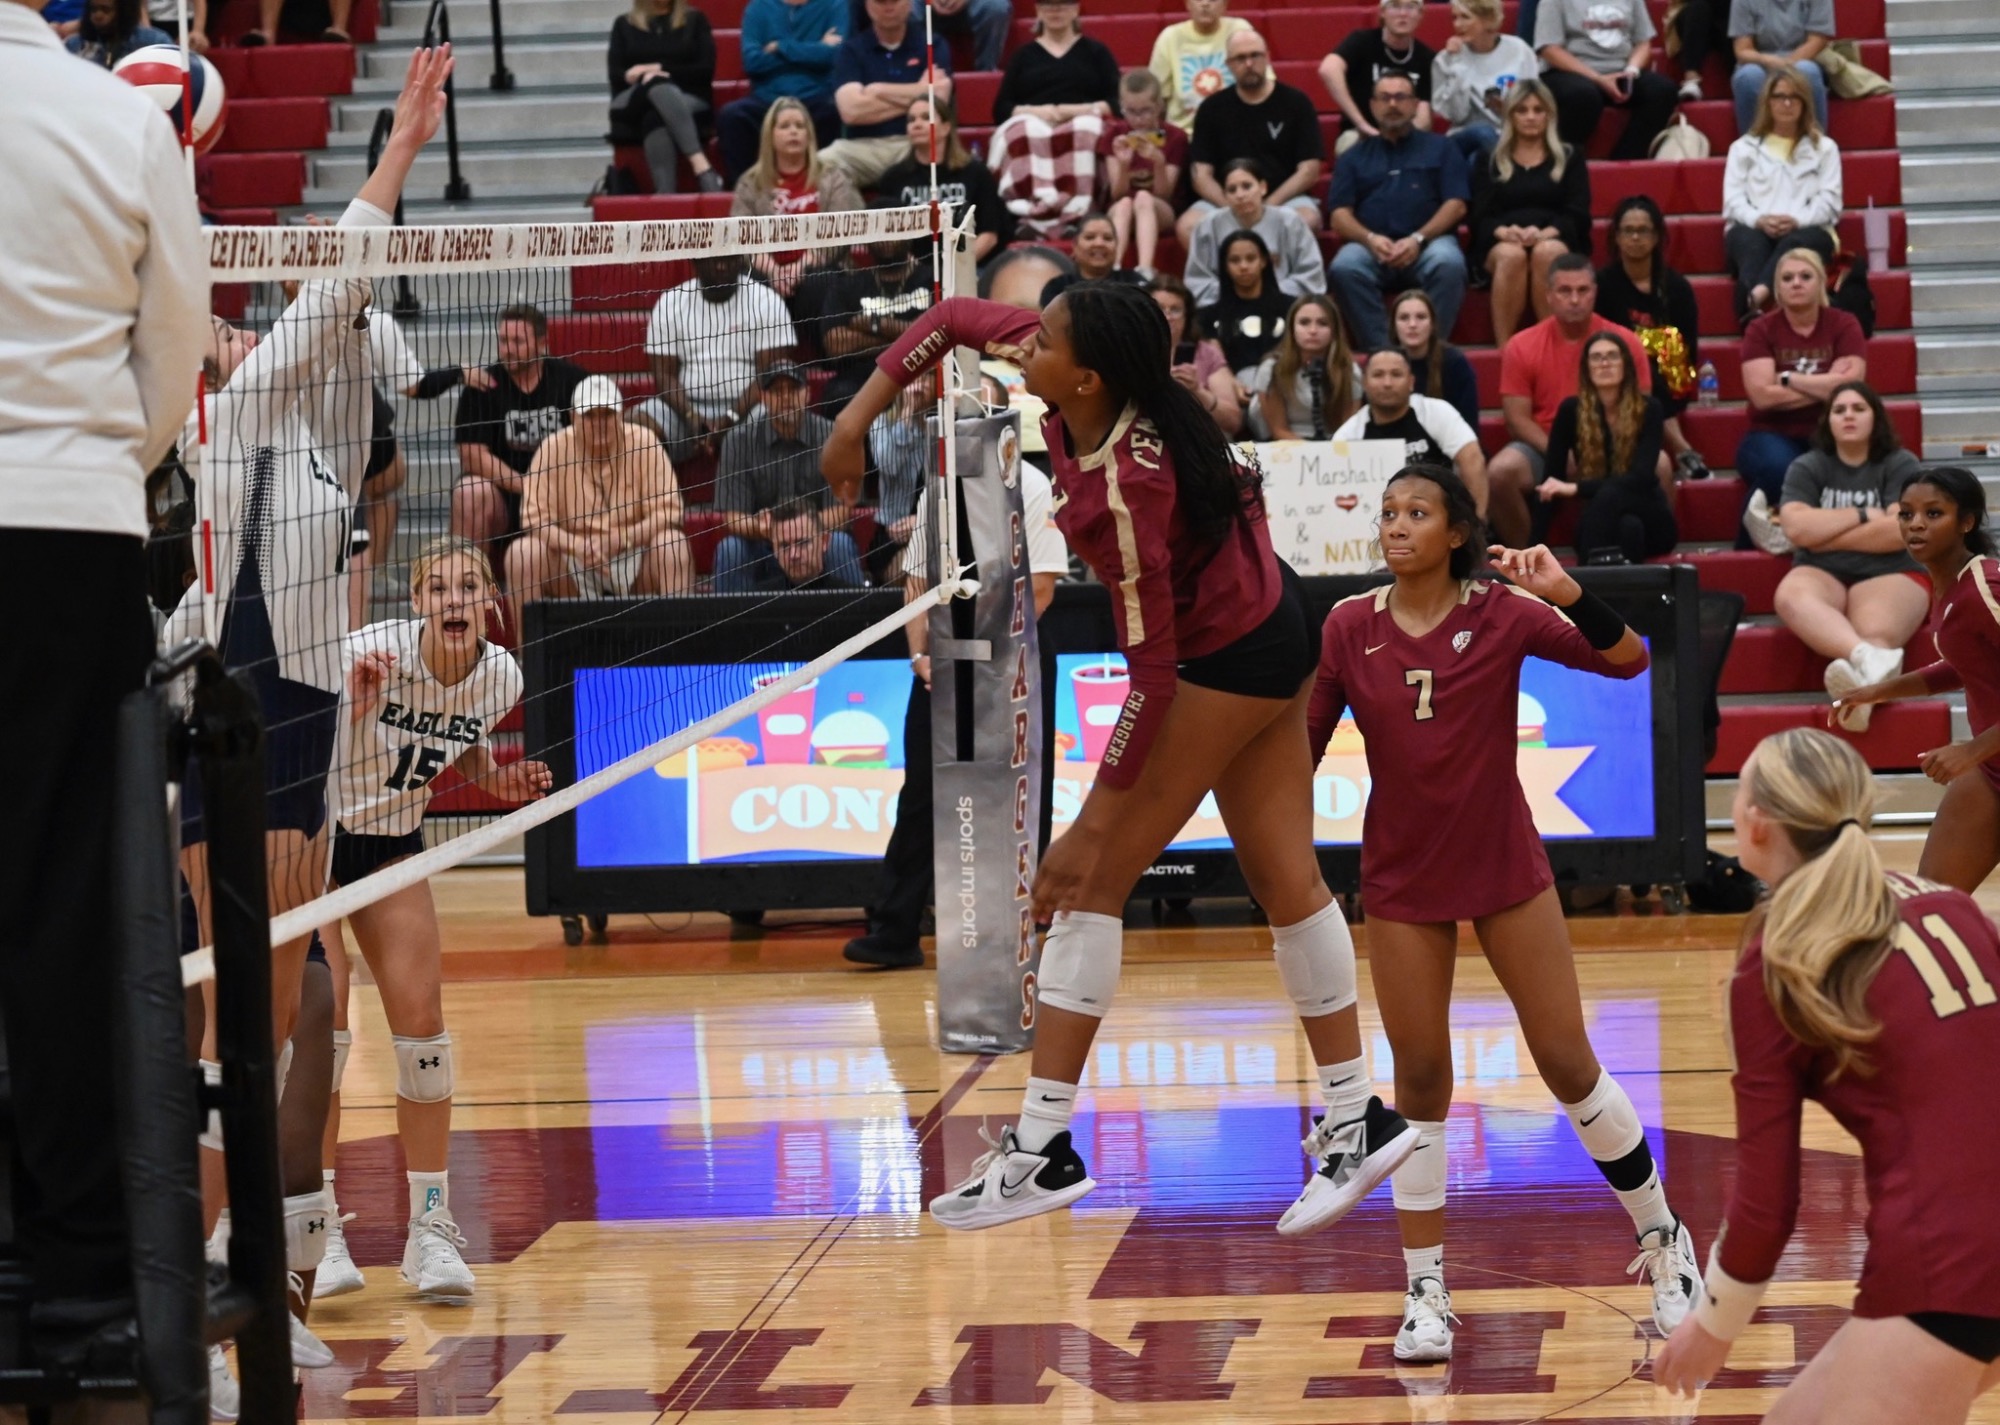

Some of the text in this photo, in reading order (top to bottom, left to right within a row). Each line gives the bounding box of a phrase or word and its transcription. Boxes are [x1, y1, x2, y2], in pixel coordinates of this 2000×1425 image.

[209, 229, 275, 269] CENTRAL
[386, 228, 494, 264] CENTRAL CHARGERS
[526, 224, 615, 258] CENTRAL CHARGERS
[640, 221, 715, 252] CENTRAL CHARGERS
[1298, 455, 1385, 487] Marshall
[1283, 503, 1299, 518] in
[1305, 503, 1325, 516] our
[1404, 668, 1435, 721] 7
[379, 701, 483, 745] EAGLES
[1104, 690, 1146, 767] CHARGERS
[383, 743, 447, 792] 15
[1009, 511, 1037, 1031] CHARGERS
[730, 784, 900, 834] CON
[955, 796, 979, 949] sports imports
[1888, 912, 1999, 1019] 11
